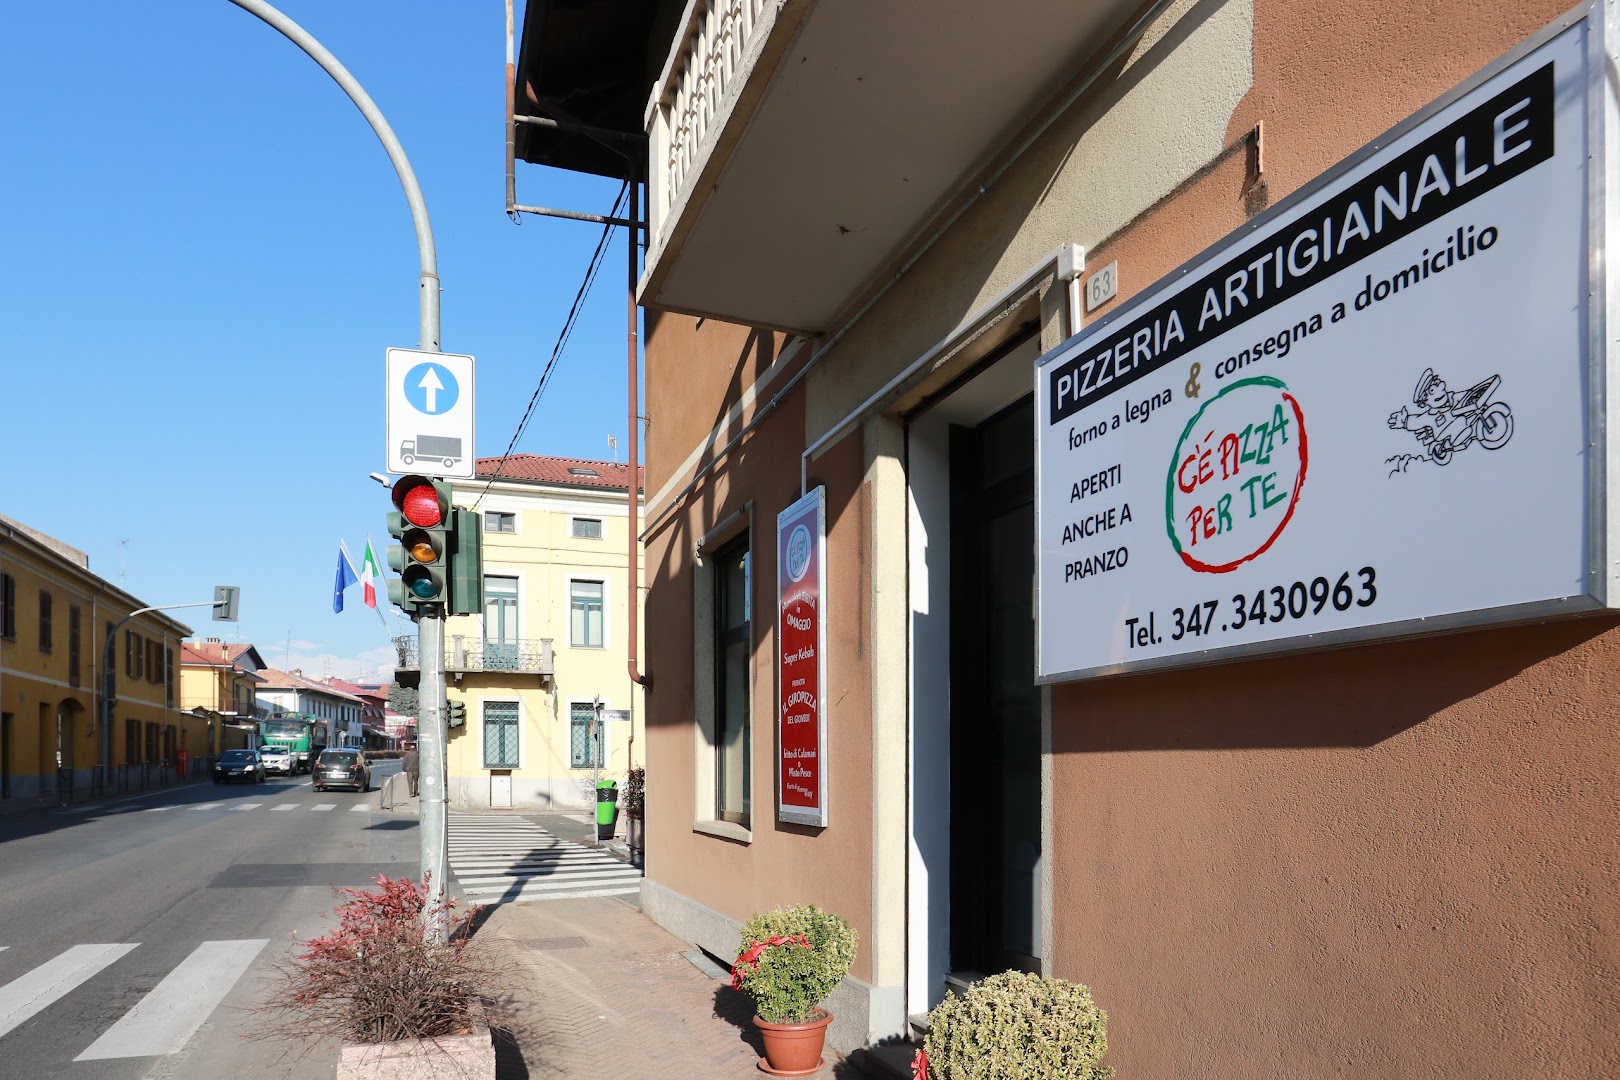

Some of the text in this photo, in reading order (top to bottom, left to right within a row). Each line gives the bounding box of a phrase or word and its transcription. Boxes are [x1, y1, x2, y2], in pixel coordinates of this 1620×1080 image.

[1056, 97, 1533, 410] PIZZERIA ARTIGIANALE
[1092, 270, 1111, 302] 63
[1068, 224, 1499, 451] forno a legna & consegna a domicilio
[1217, 403, 1290, 481] PIZZA
[1070, 463, 1122, 504] APERTI
[1061, 502, 1133, 546] ANCHE A
[1186, 471, 1288, 547] PER TE
[1065, 546, 1129, 584] PRANZO
[787, 613, 811, 631] OMAGGIO
[1125, 566, 1378, 649] Tel. 347.3430963
[784, 644, 815, 666] Super Kebab
[787, 690, 817, 712] GIROPIZZA
